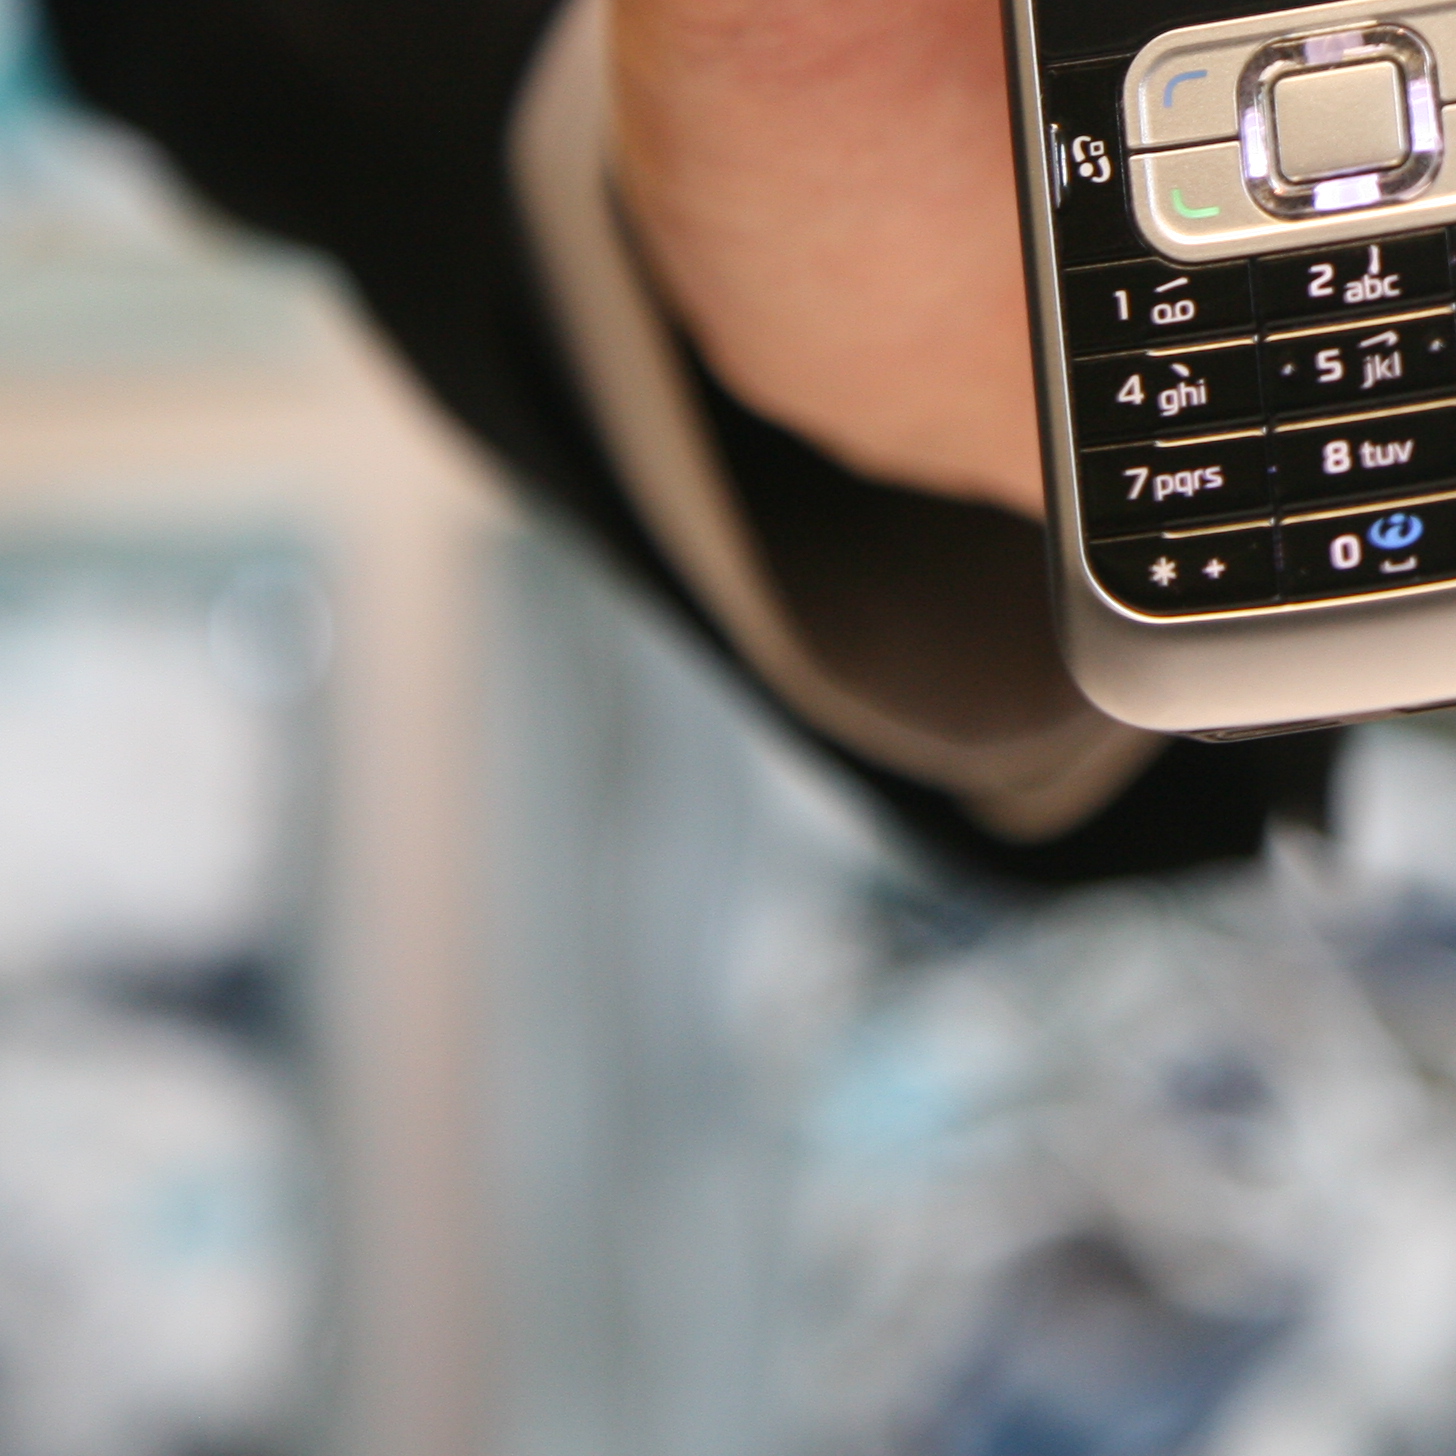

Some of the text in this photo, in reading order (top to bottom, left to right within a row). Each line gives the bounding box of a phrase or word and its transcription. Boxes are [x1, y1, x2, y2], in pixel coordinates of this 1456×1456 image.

[1308, 262, 1401, 305] 2 abc
[1113, 289, 1131, 322] 1
[1315, 348, 1403, 391] 5 jkl
[1115, 373, 1208, 418] 4 ghi
[1322, 439, 1414, 475] 8 tuv
[1123, 464, 1225, 502] 7 pqrs
[1329, 533, 1362, 570] 0
